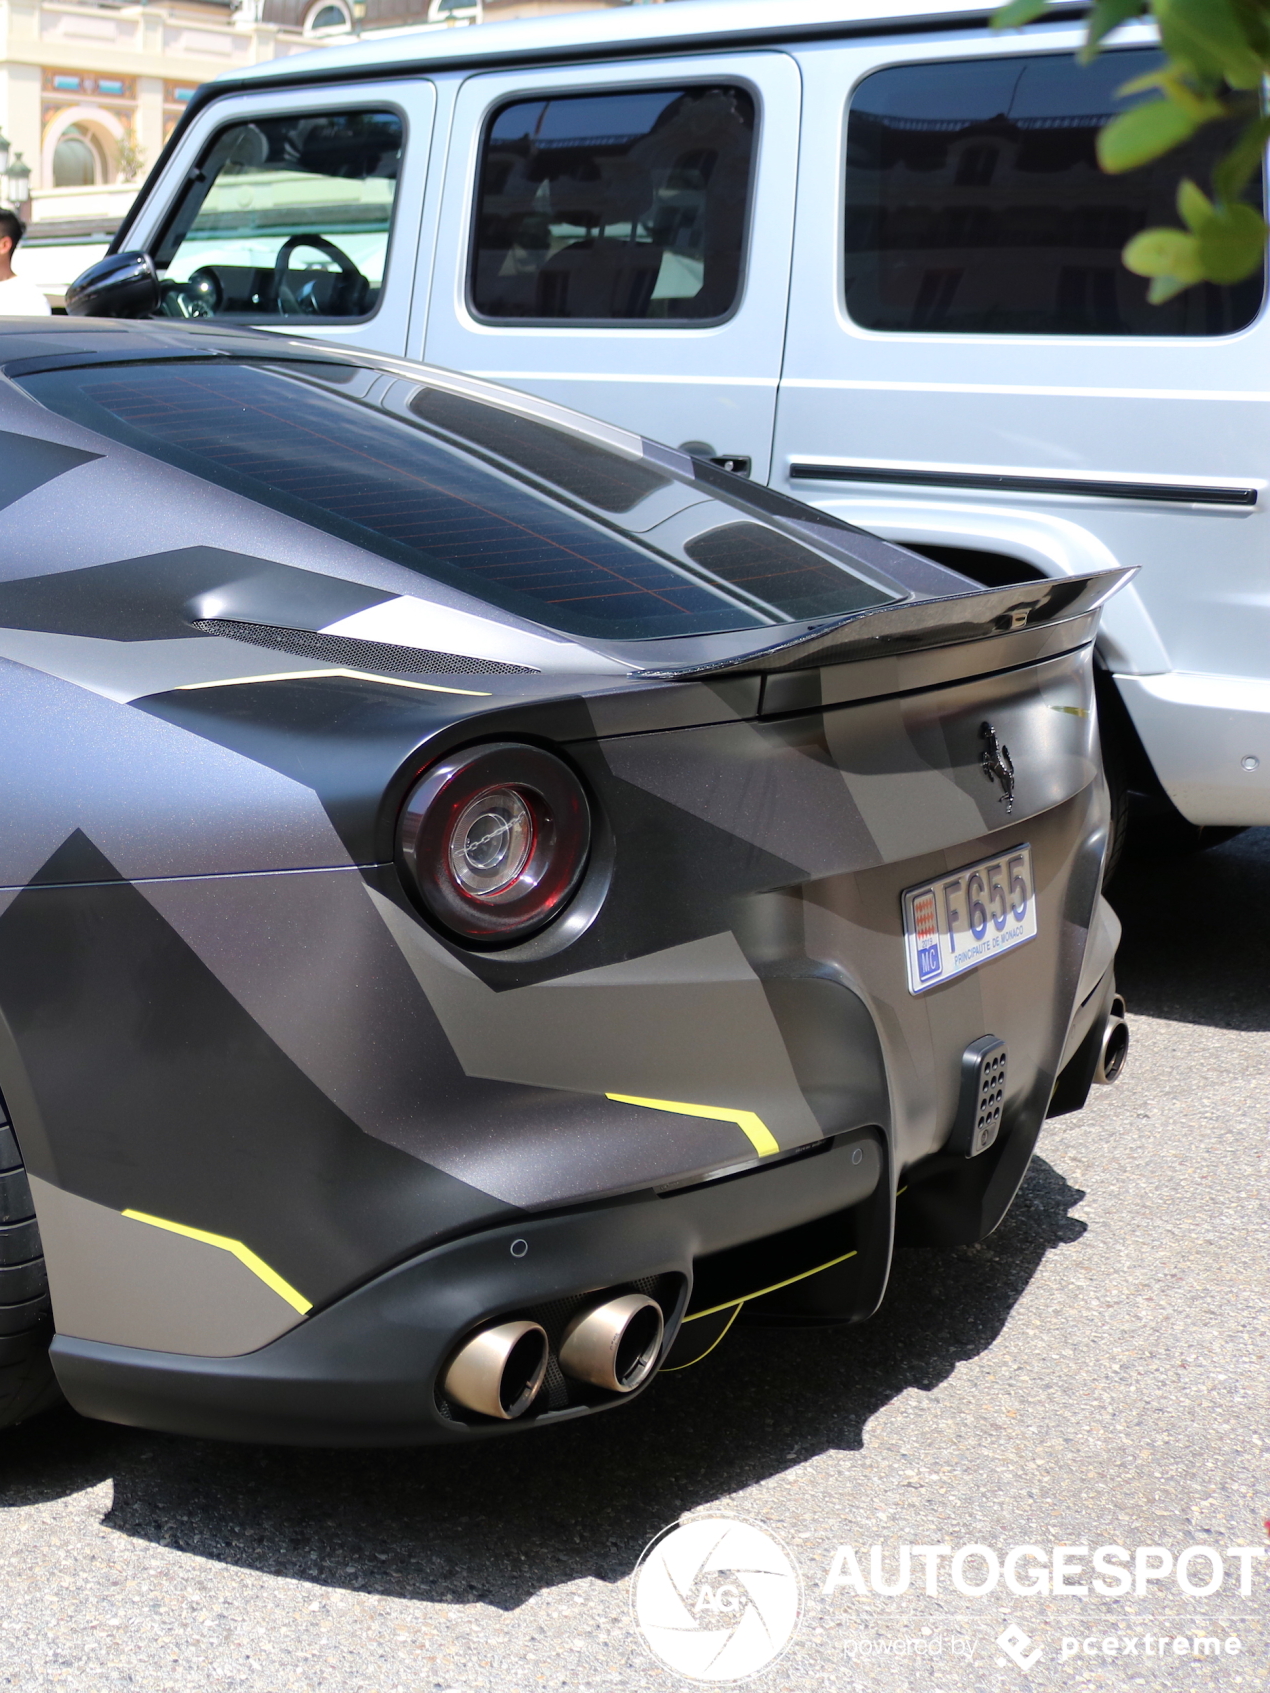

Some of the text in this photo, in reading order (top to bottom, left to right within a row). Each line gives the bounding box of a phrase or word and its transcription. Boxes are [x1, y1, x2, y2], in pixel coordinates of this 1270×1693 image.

[944, 854, 1027, 953] F655
[992, 936, 1000, 948] DE
[1001, 925, 1024, 944] MONACO
[921, 949, 936, 973] MC
